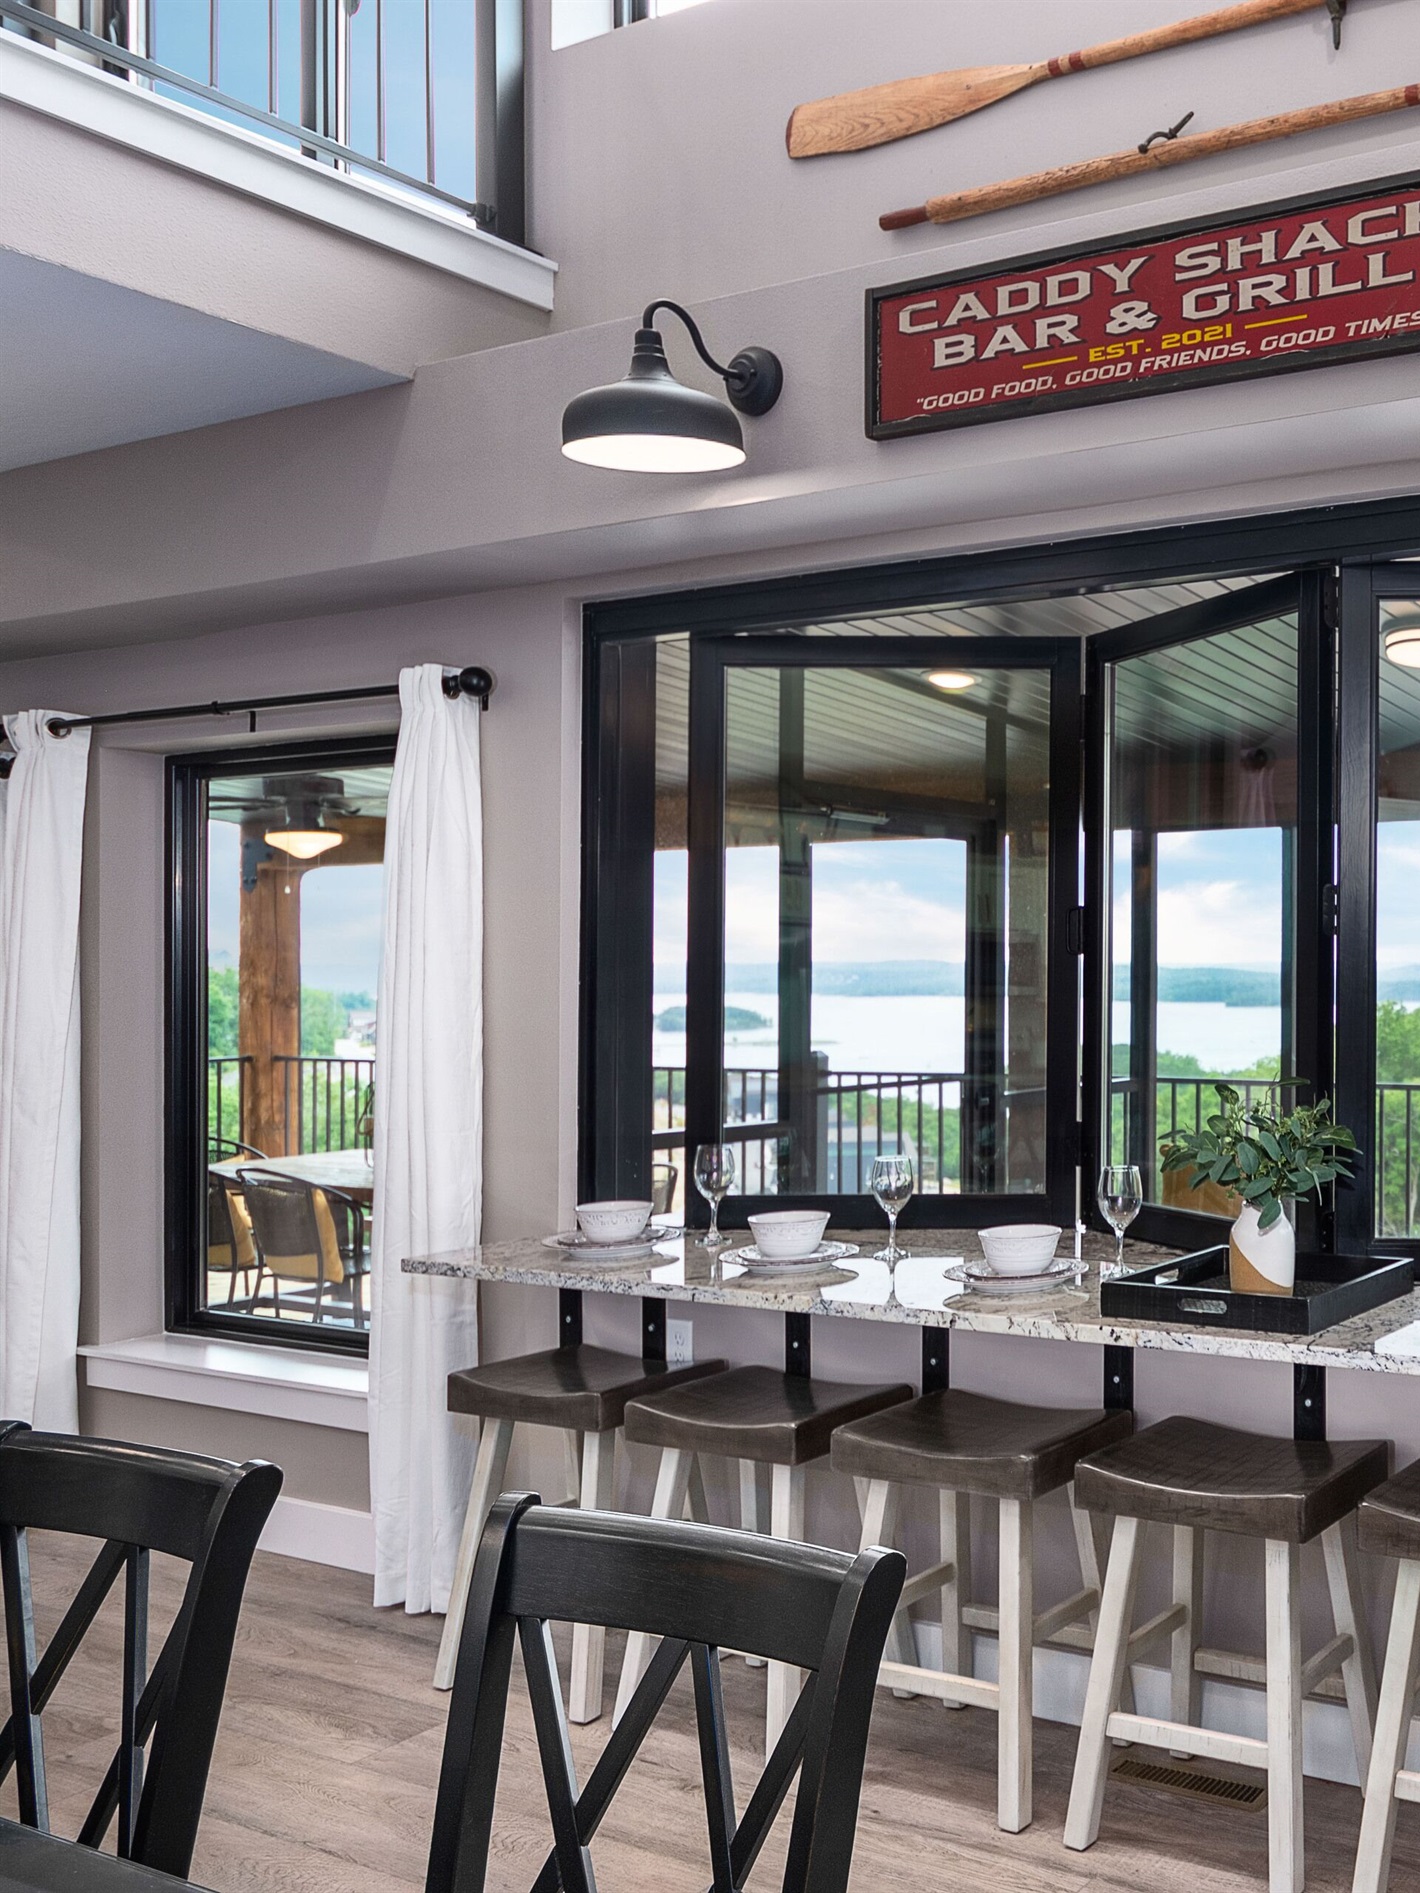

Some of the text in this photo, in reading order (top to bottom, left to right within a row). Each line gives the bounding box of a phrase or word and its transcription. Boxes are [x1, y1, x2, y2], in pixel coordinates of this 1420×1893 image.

[898, 256, 1149, 334] CADDY
[932, 252, 1415, 368] BAR & GRILL
[916, 386, 985, 411] "GOOD
[990, 376, 1057, 399] FOOD,
[1064, 361, 1132, 386] GOOD
[1138, 341, 1251, 374] FRIENDS,
[1259, 325, 1336, 352] GOOD
[1088, 323, 1233, 363] EST. 2021
